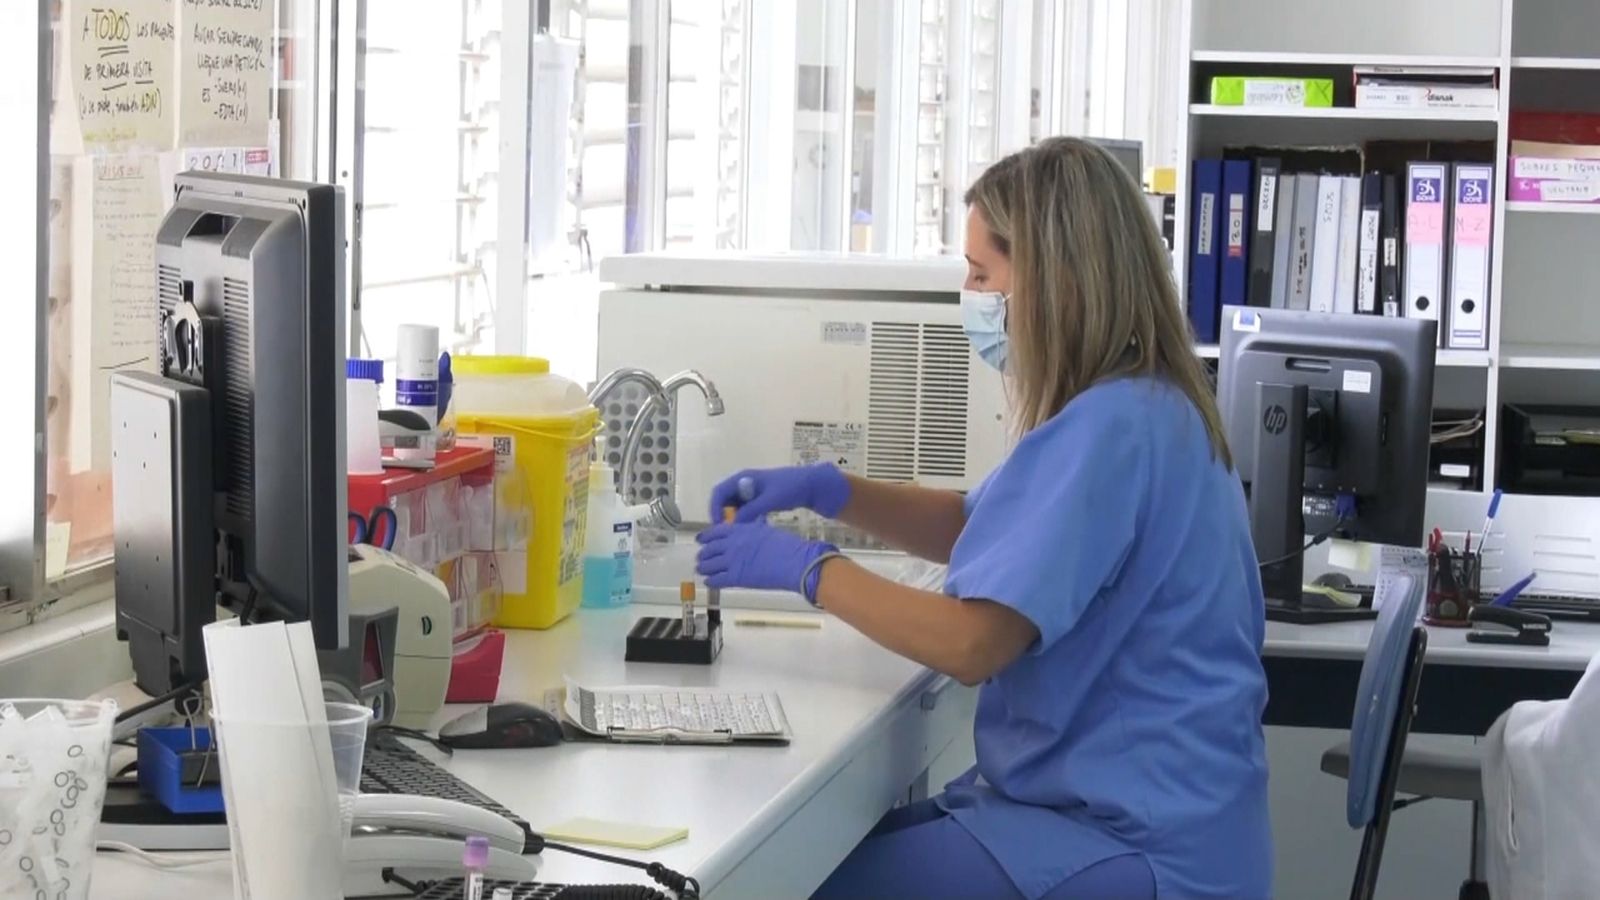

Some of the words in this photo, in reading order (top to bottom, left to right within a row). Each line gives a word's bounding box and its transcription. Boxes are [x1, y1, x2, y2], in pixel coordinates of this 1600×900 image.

[82, 15, 90, 40] A
[91, 8, 130, 41] TODOS
[136, 22, 149, 38] LOS
[83, 63, 92, 80] DE
[96, 61, 130, 79] PRIMERA
[133, 59, 153, 78] VISITA
[1264, 404, 1288, 436] hp
